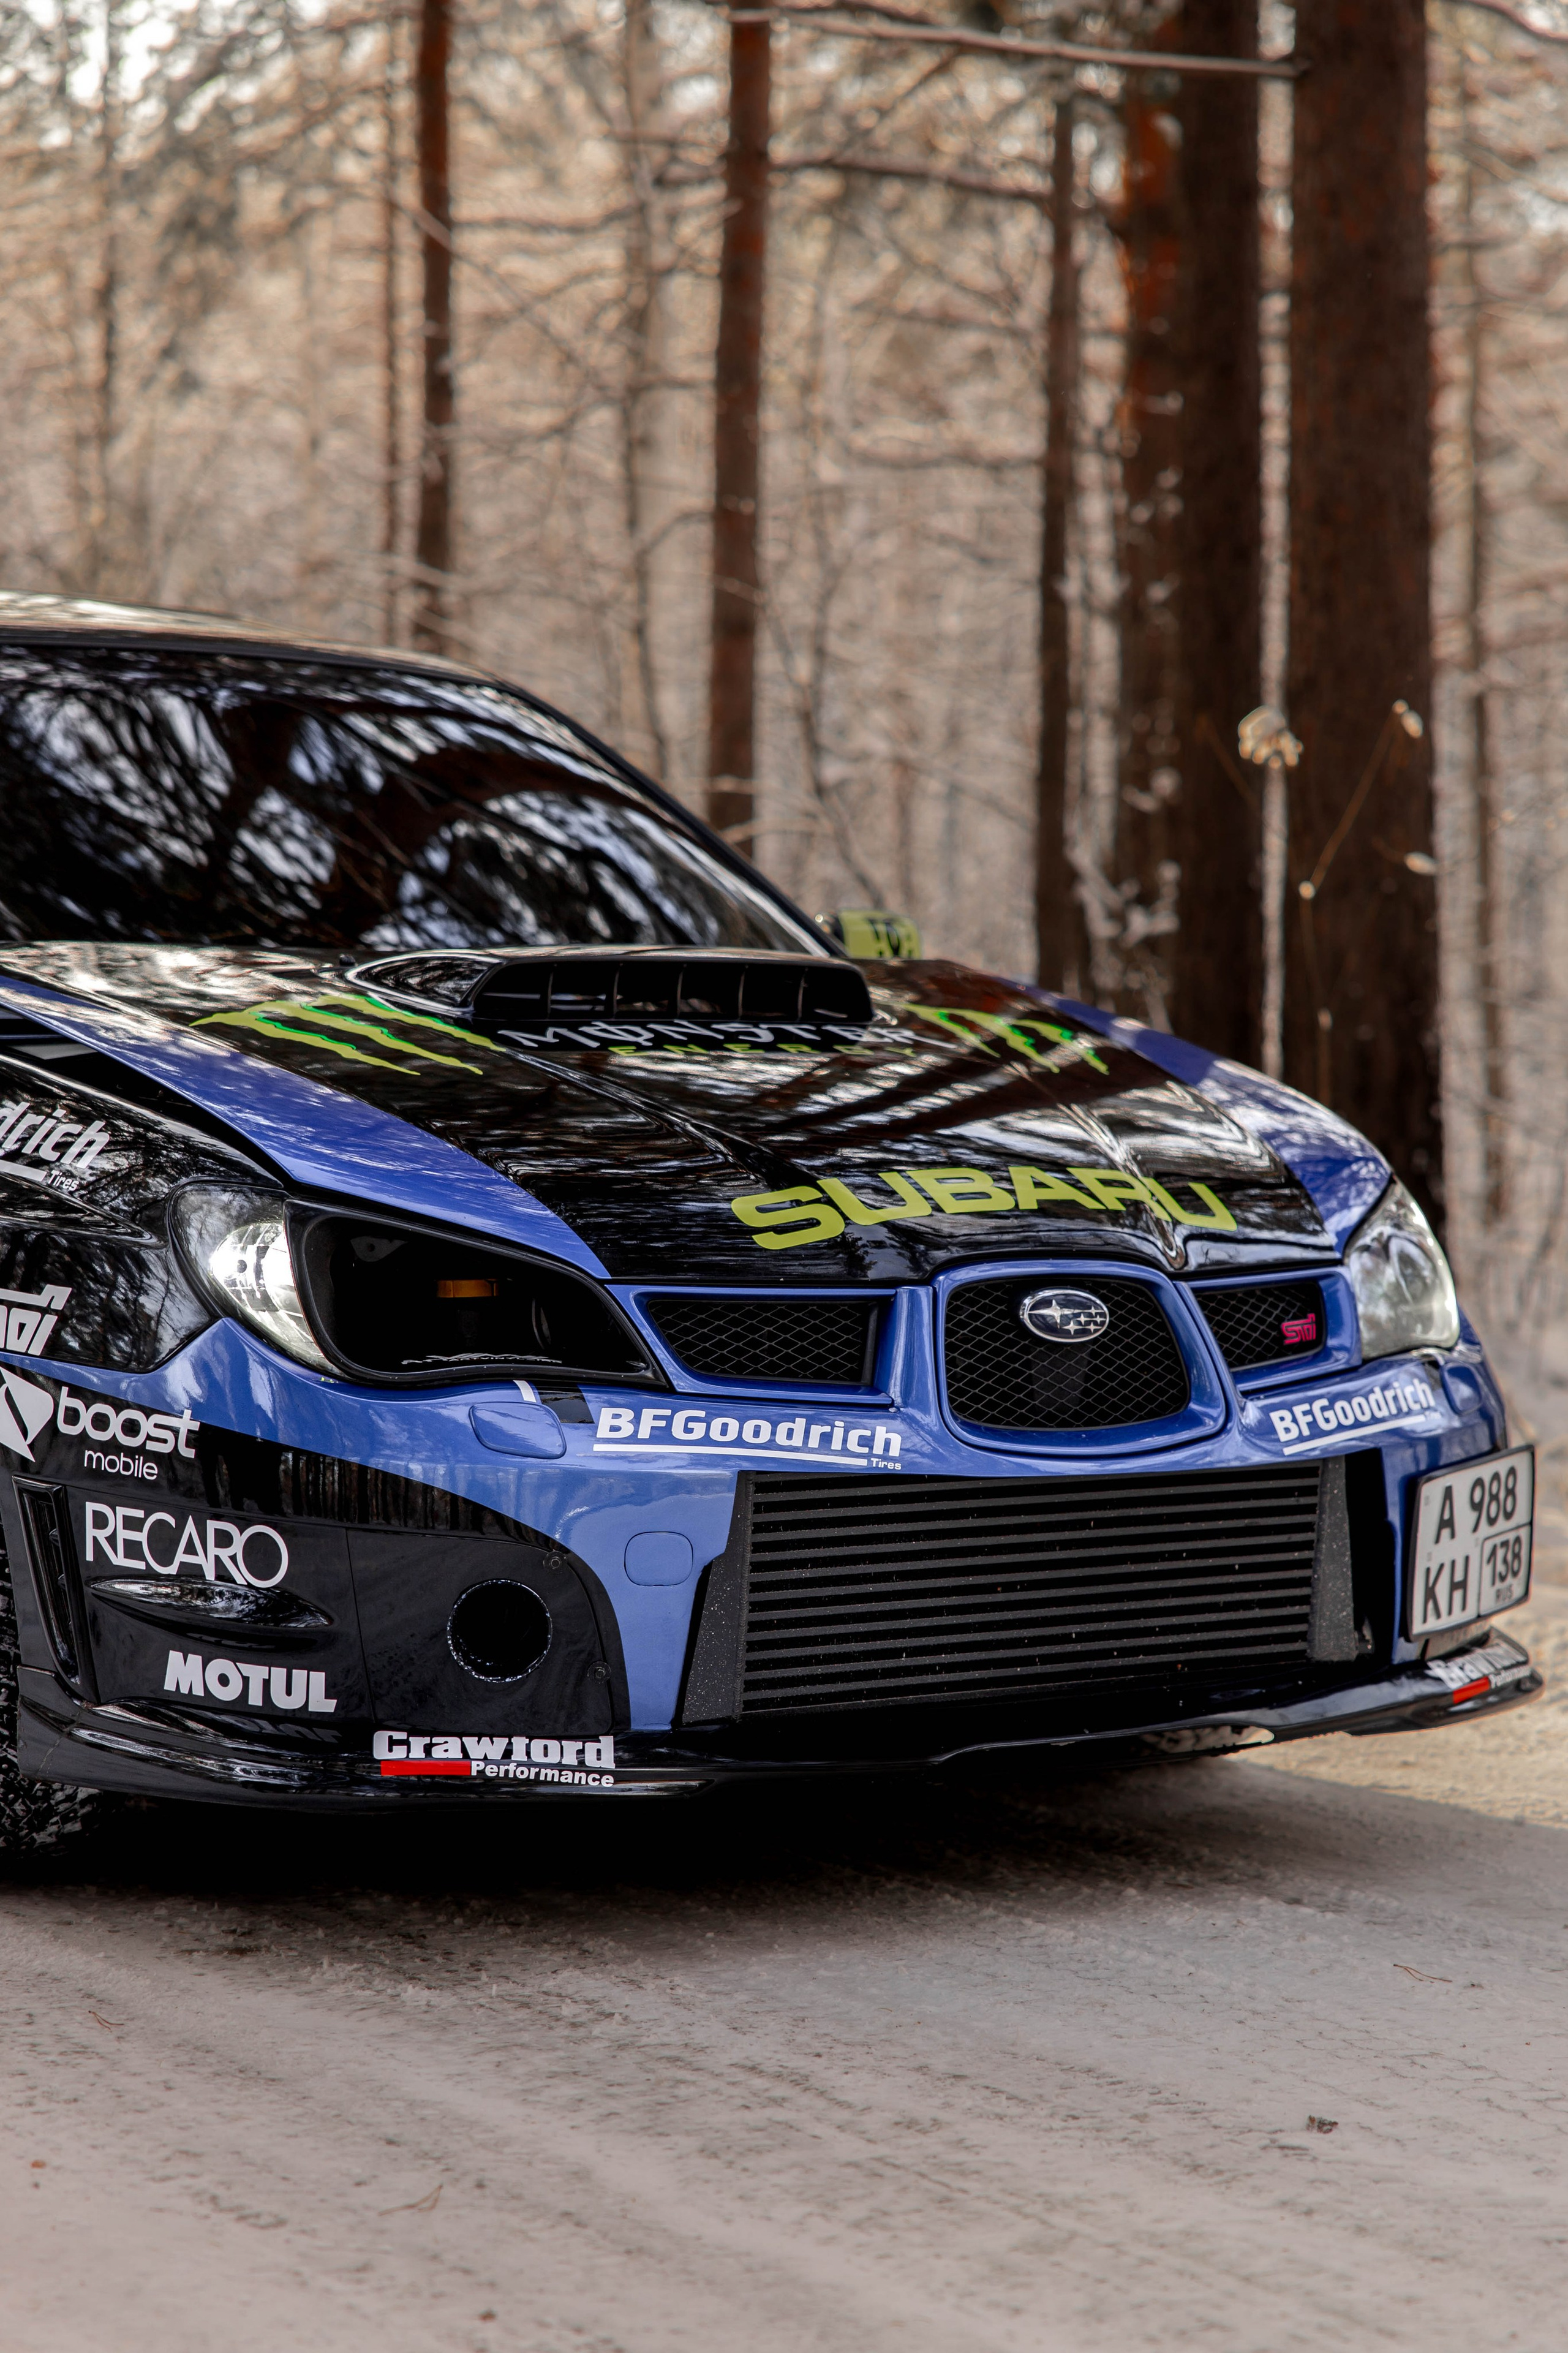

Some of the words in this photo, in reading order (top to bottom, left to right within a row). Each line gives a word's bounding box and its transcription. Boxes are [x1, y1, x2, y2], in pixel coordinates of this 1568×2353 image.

[608, 1043, 917, 1057] ENERGY
[48, 1170, 80, 1192] Tires
[731, 1166, 1237, 1250] SUBARU
[58, 1386, 200, 1459] boost
[596, 1407, 902, 1457] BFGoodrich
[1269, 1378, 1436, 1443] BFGoodrich
[85, 1449, 159, 1481] mobile
[870, 1458, 902, 1470] Tires
[1434, 1484, 1455, 1544] A
[1469, 1465, 1517, 1533] 988
[85, 1501, 289, 1588] RECARO
[1422, 1555, 1470, 1624] KH
[1486, 1534, 1523, 1587] 138
[1494, 1584, 1514, 1604] RUS
[164, 1650, 337, 1713] MOTUL
[372, 1731, 616, 1769] Crawford
[470, 1760, 614, 1788] Performance
